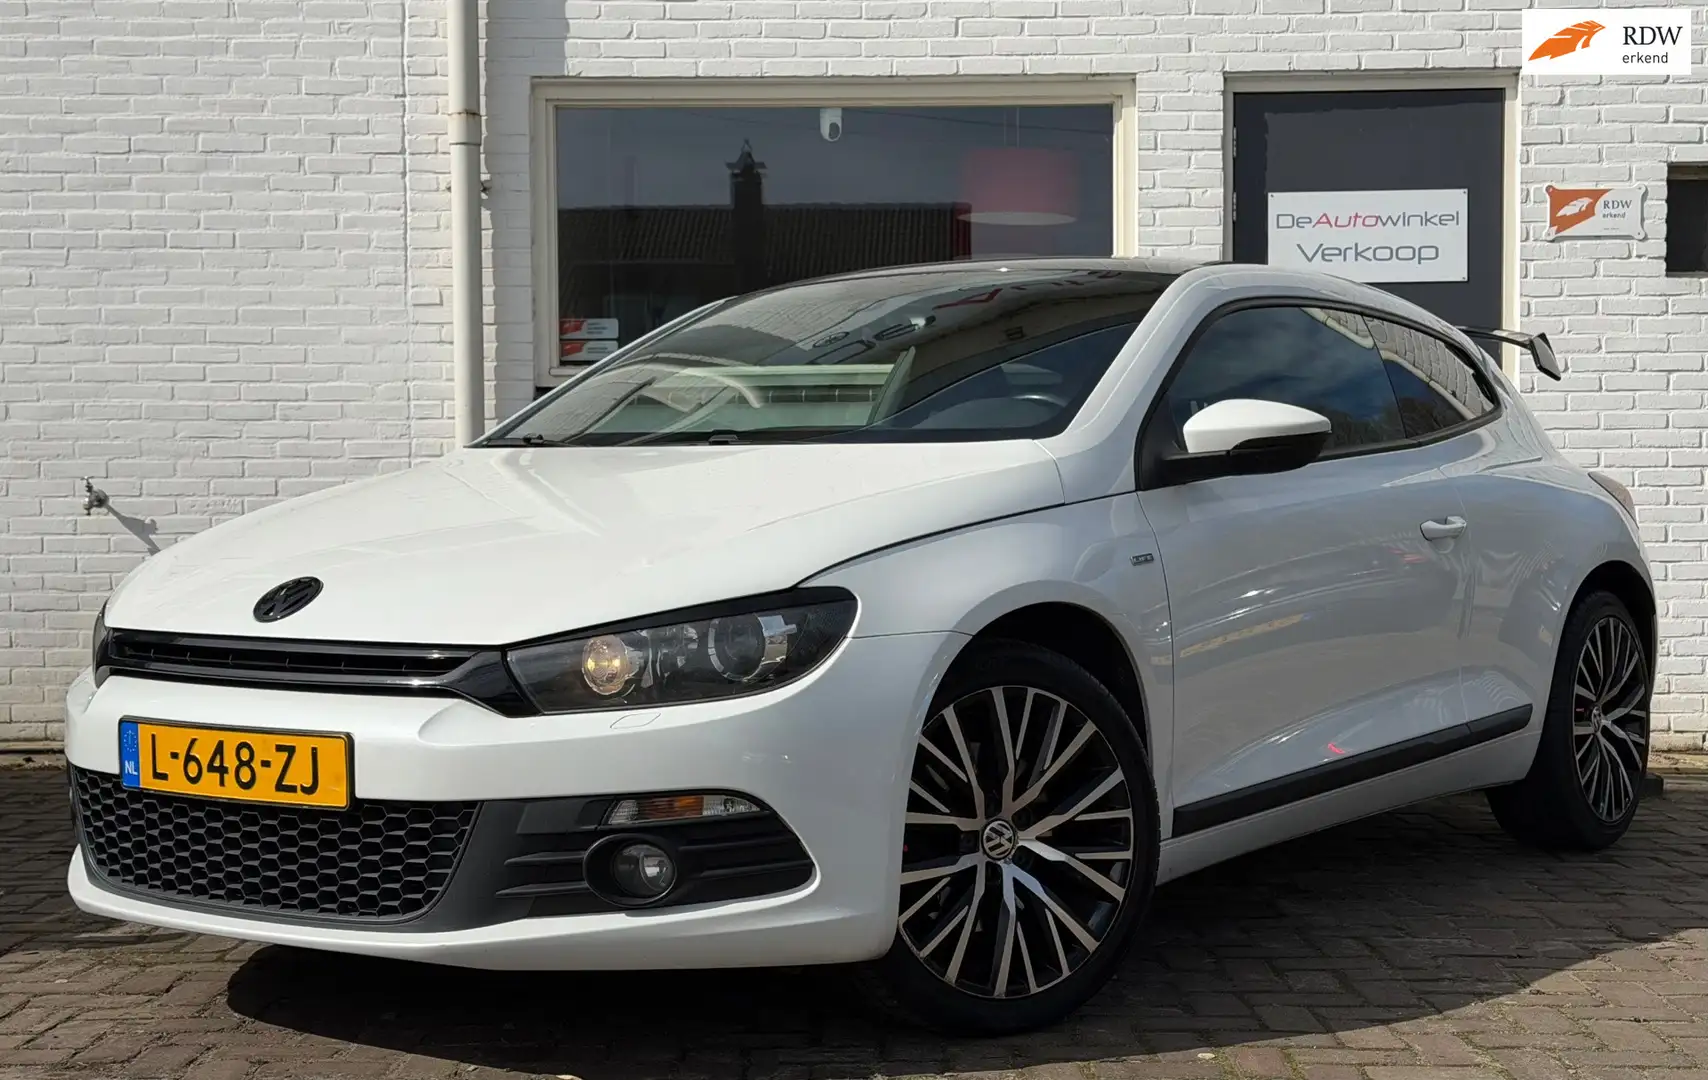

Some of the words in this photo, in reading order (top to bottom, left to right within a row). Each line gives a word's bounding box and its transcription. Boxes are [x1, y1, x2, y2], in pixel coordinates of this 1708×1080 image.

[1603, 199, 1633, 210] RDW
[1276, 211, 1460, 229] DeAutowinkel
[1602, 211, 1626, 219] erkend
[1296, 242, 1440, 265] Verkoop
[124, 759, 139, 776] NL
[150, 733, 319, 796] L-648-ZJ
